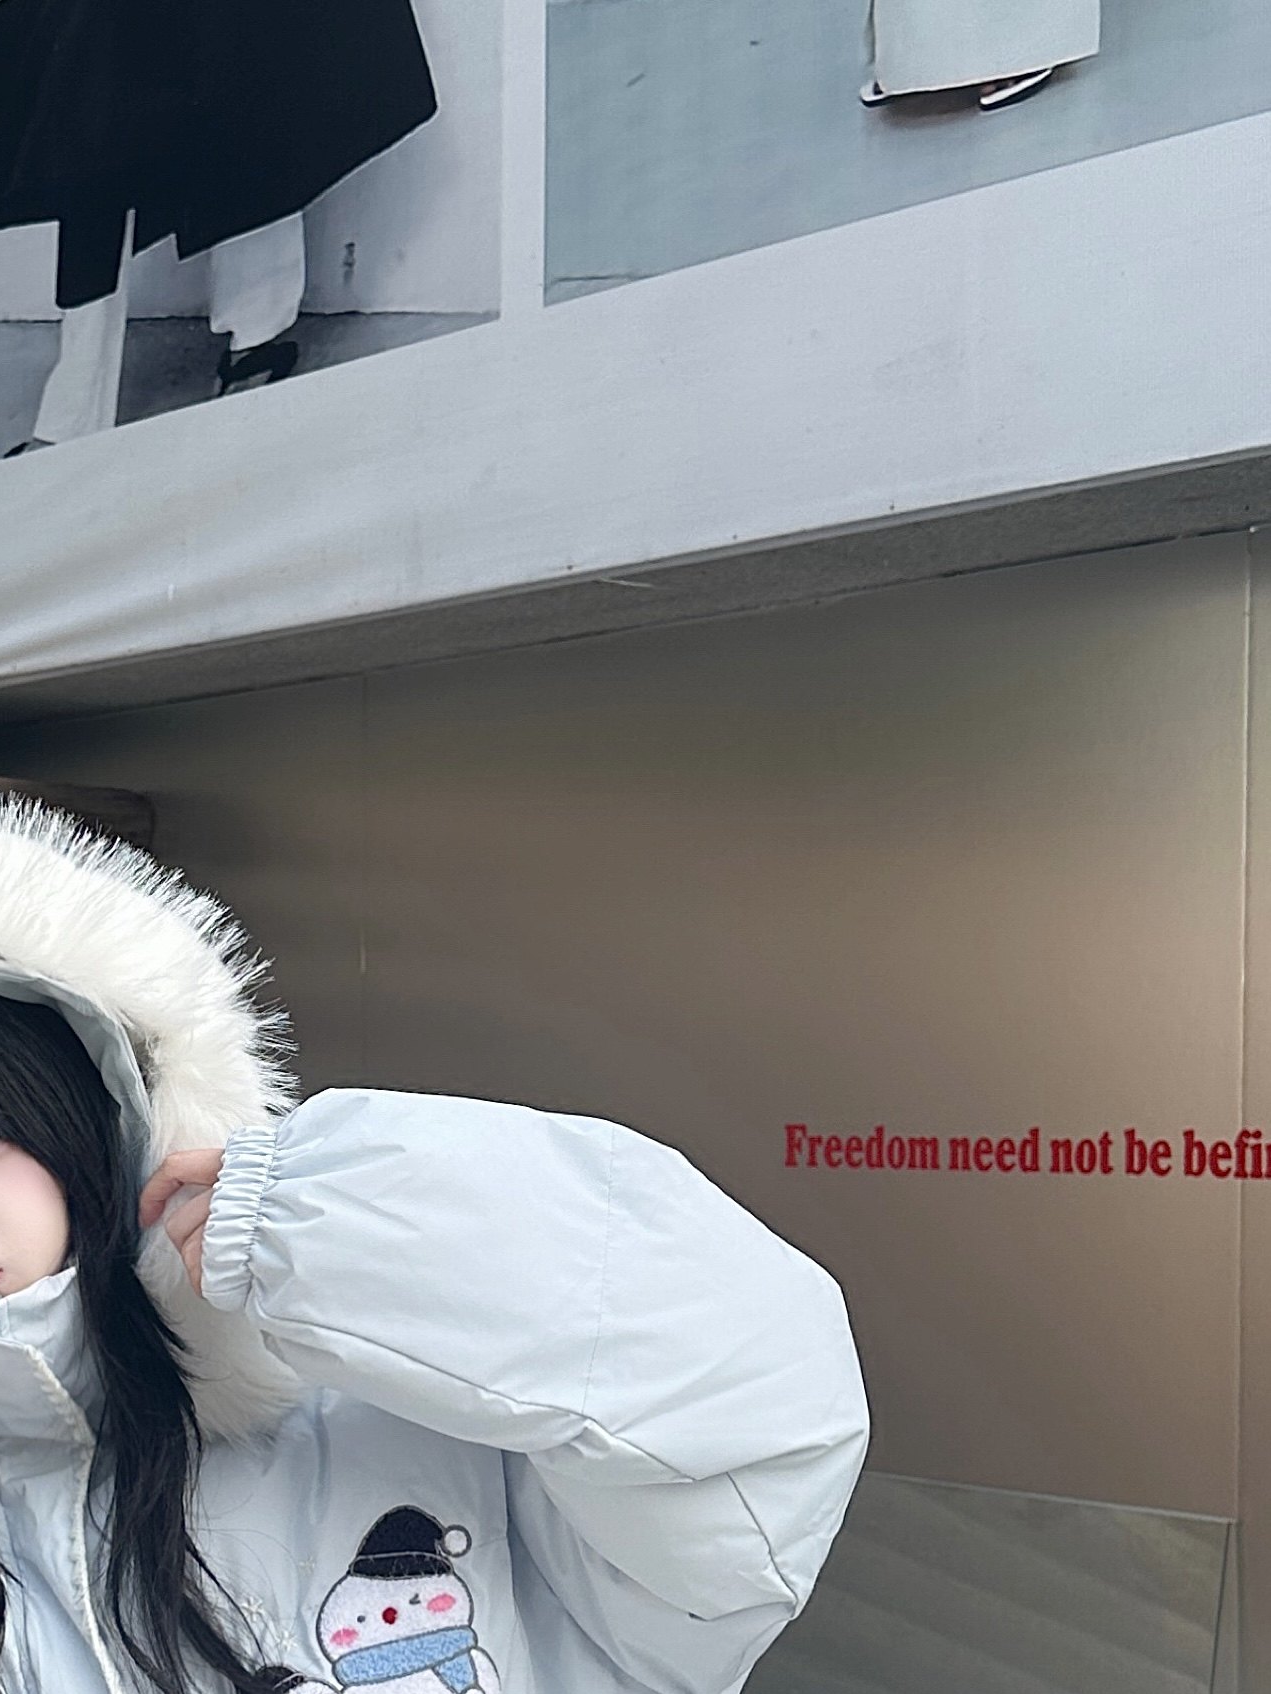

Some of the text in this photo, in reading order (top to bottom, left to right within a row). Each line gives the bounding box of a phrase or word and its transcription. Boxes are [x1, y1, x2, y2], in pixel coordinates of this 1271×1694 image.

[784, 1123, 941, 1171] Freedom
[948, 1127, 1041, 1174] need
[1049, 1131, 1114, 1175] not
[1124, 1128, 1172, 1177] be
